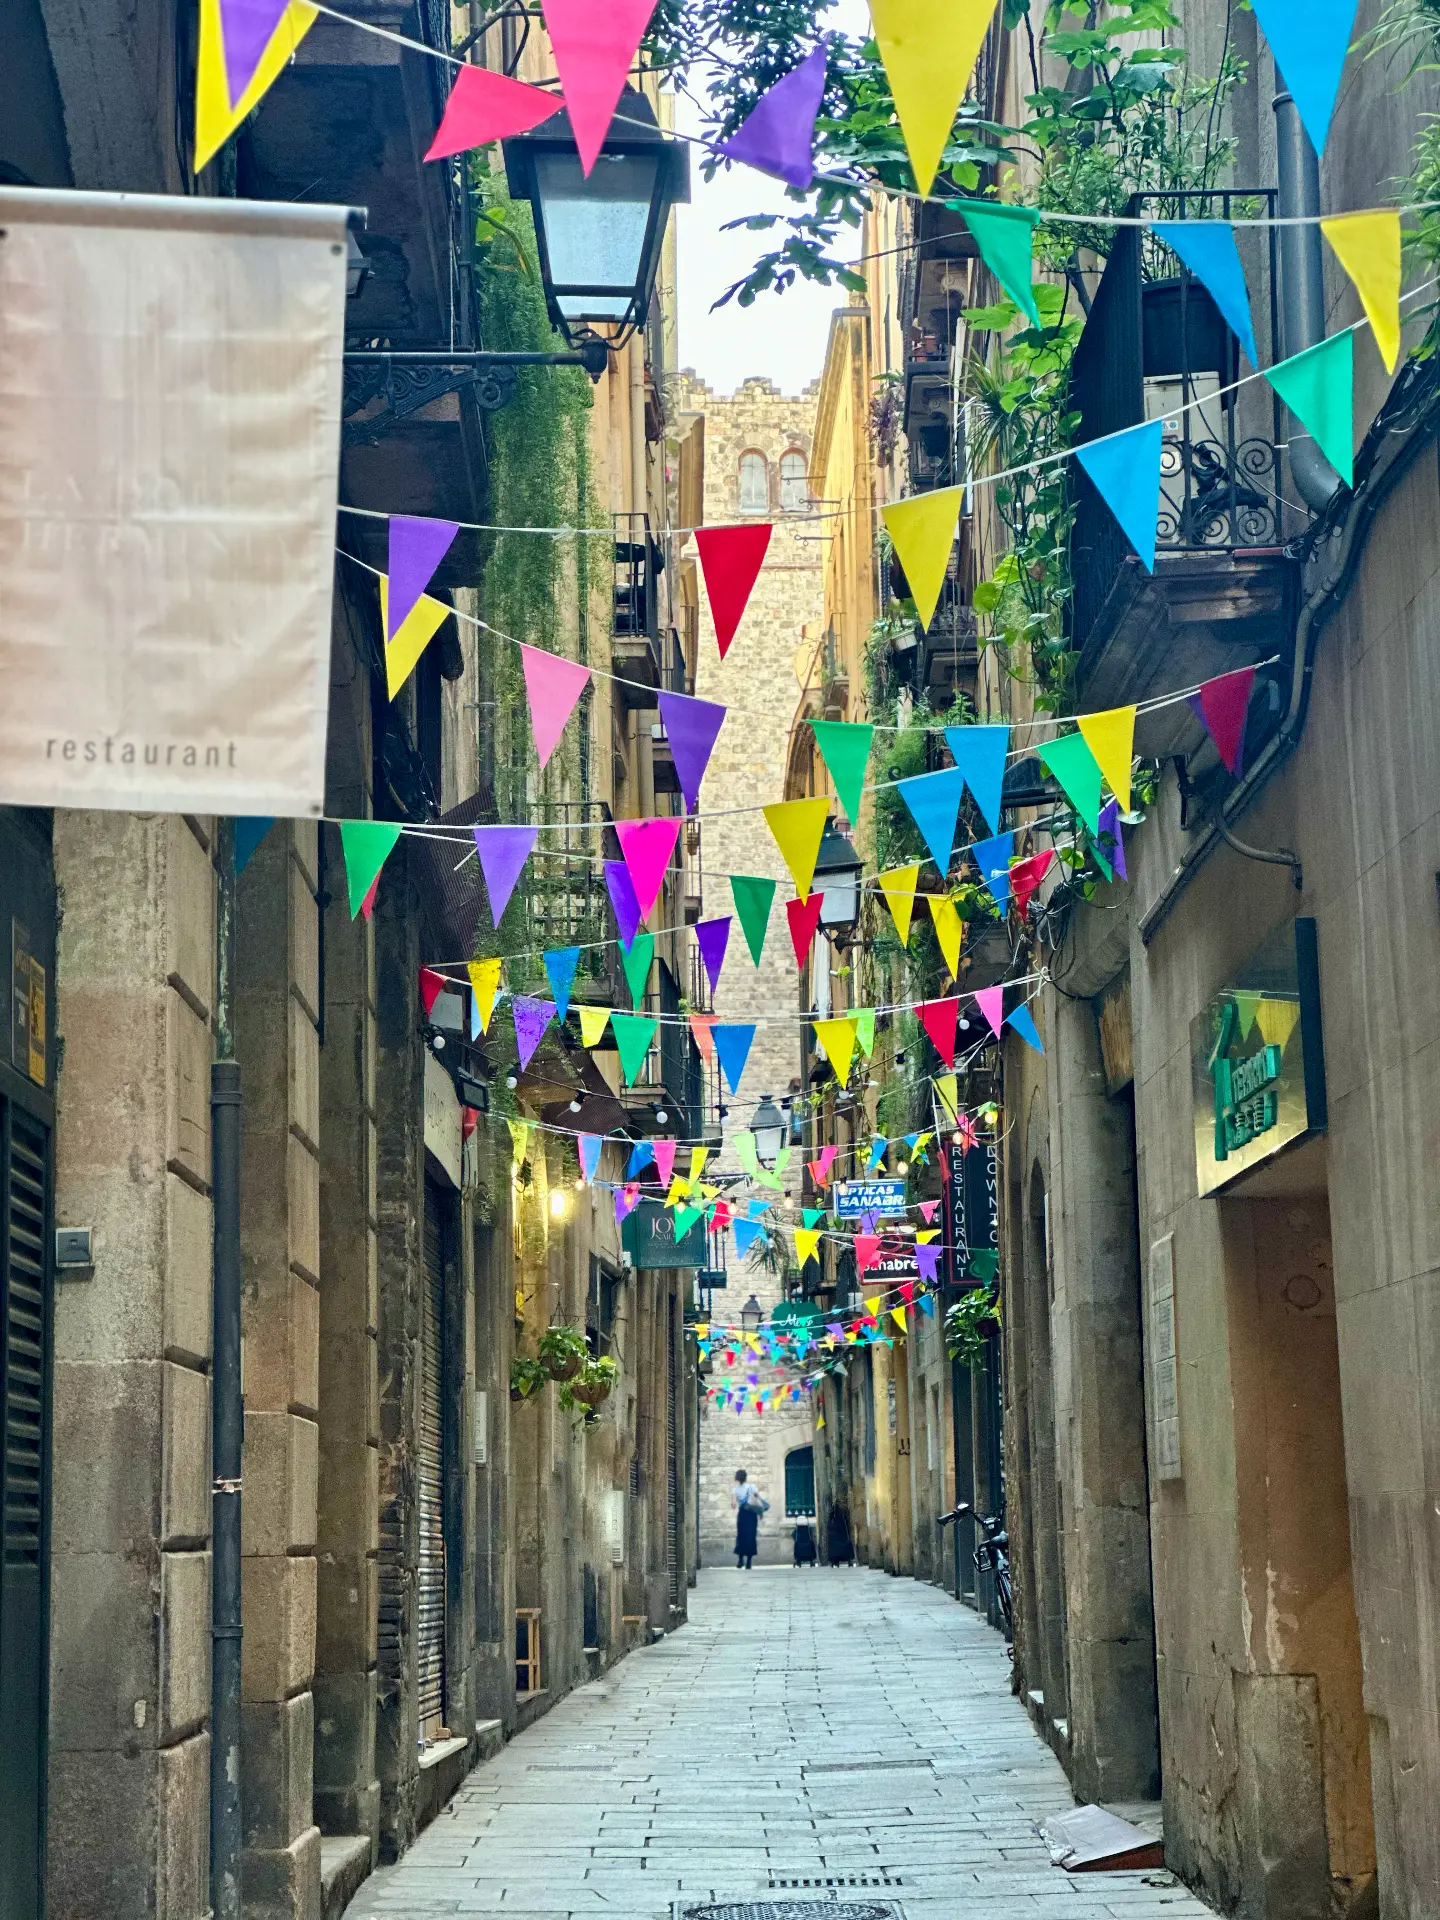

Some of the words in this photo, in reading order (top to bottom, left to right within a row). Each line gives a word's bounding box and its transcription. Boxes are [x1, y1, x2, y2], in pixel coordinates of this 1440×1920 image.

[45, 738, 238, 767] restaurant
[838, 1185, 895, 1196] PTICAS
[952, 1146, 967, 1278] RESTAURANT
